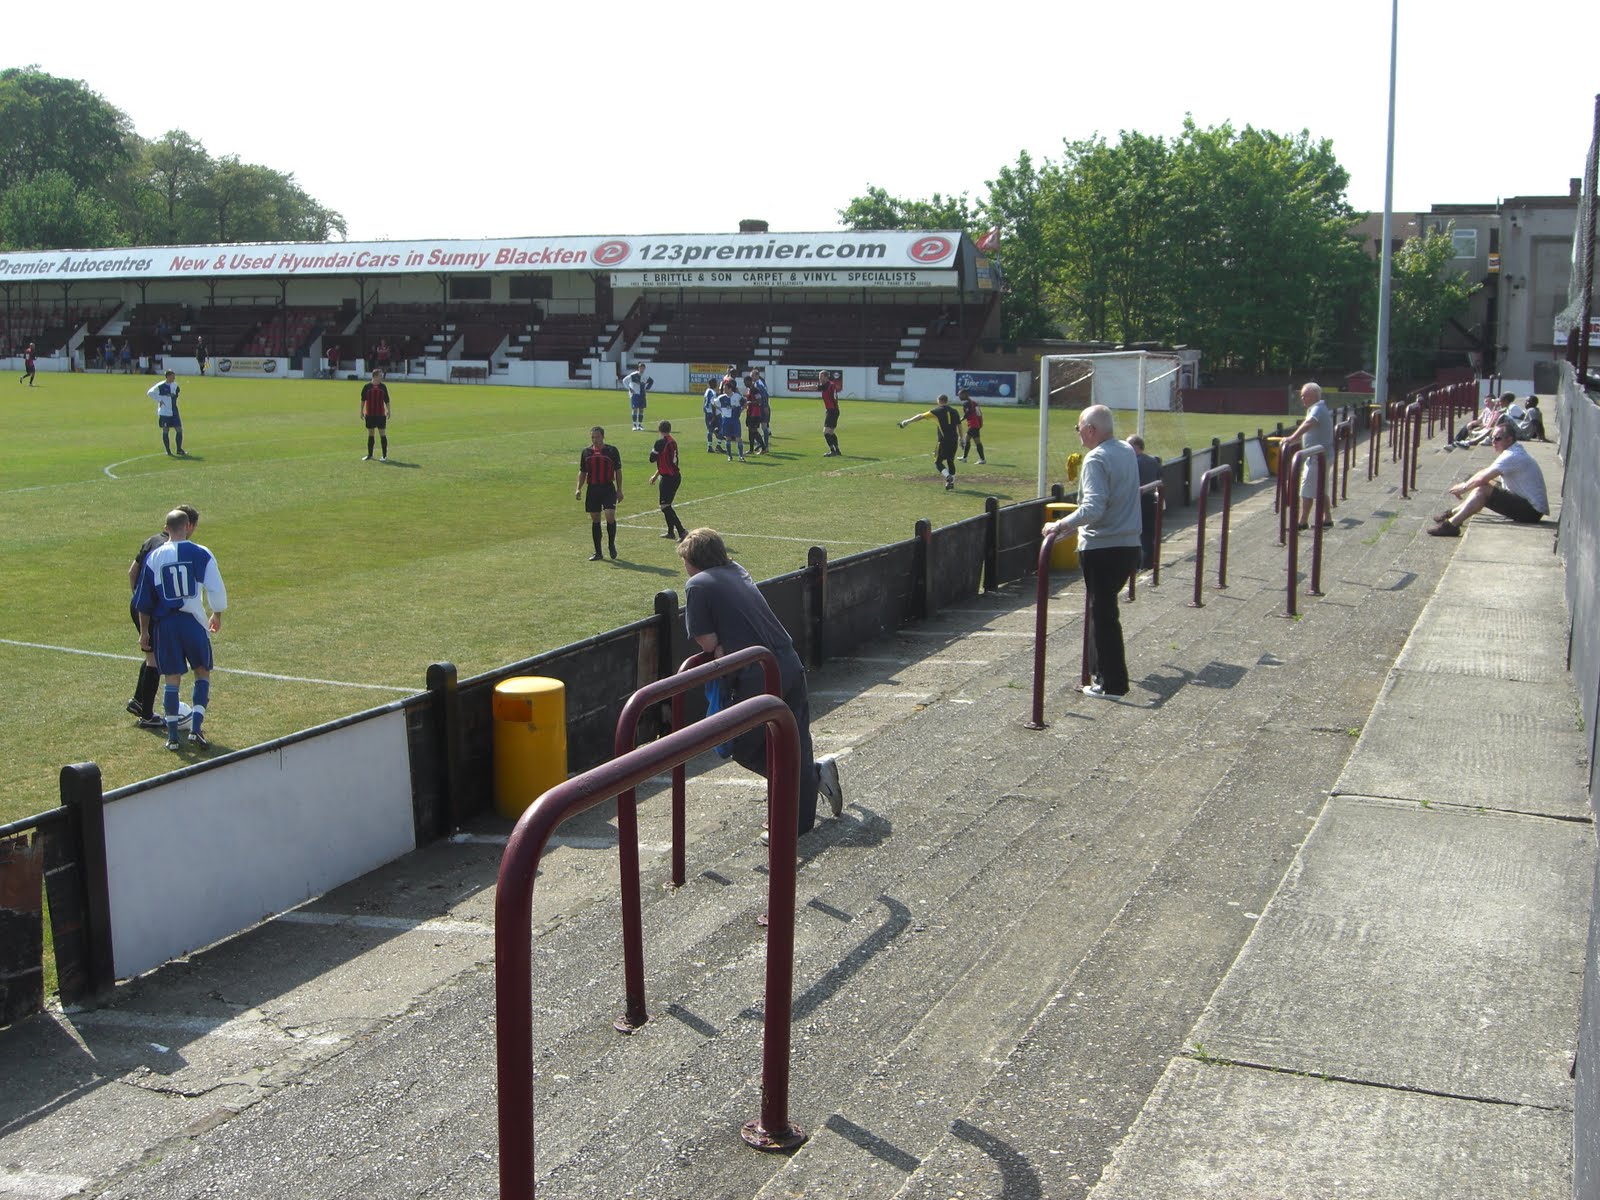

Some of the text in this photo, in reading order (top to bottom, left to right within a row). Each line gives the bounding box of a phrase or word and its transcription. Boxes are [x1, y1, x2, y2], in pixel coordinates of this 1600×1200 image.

[169, 247, 587, 272] New & Used Hyundai Cars in Sunny Blackfen
[639, 240, 887, 264] 123premier.com
[0, 256, 153, 275] Premier Autocentres
[643, 272, 917, 281] E BRITTLE & SON CARPET & VINYL SPECIALISTS
[946, 411, 952, 425] 1
[169, 565, 189, 597] 11
